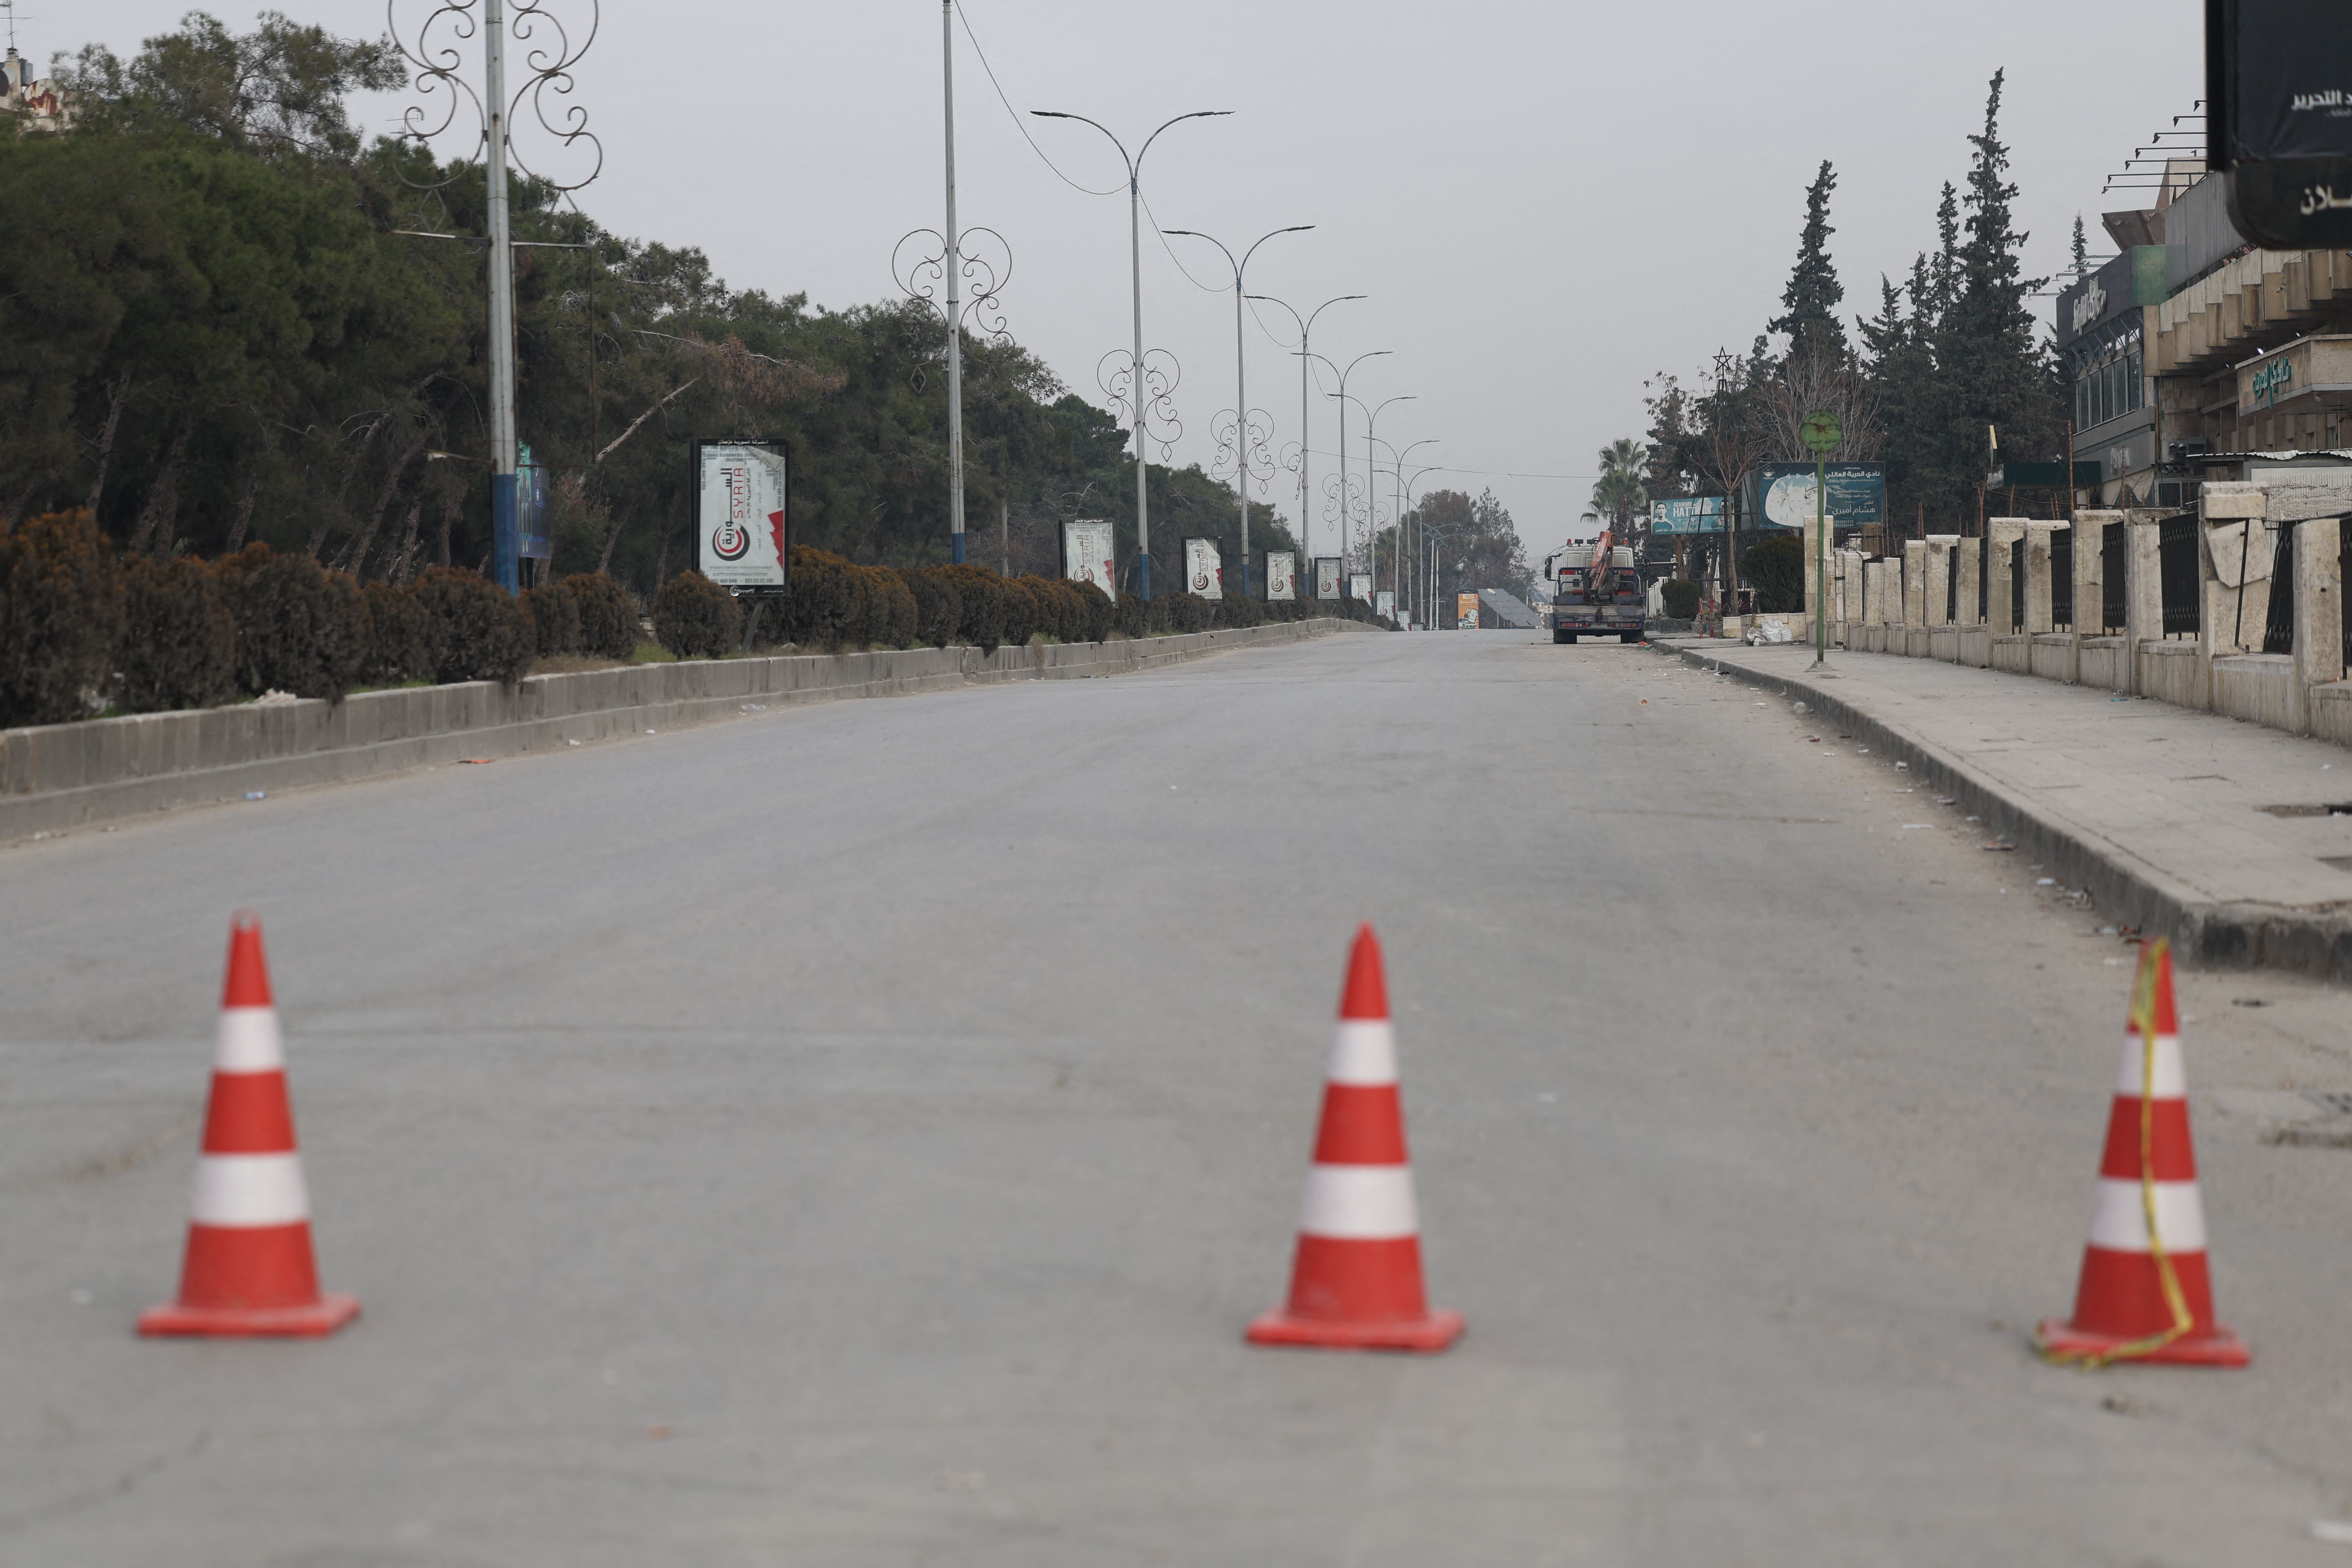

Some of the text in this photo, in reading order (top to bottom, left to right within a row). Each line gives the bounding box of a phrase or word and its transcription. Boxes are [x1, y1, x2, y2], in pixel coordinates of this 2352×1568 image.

[2291, 89, 2342, 111] التحرير
[720, 468, 734, 544] السورية
[733, 468, 743, 519] SYRIA
[1832, 504, 1875, 516] هشام أميري
[1076, 535, 1086, 579] السورية
